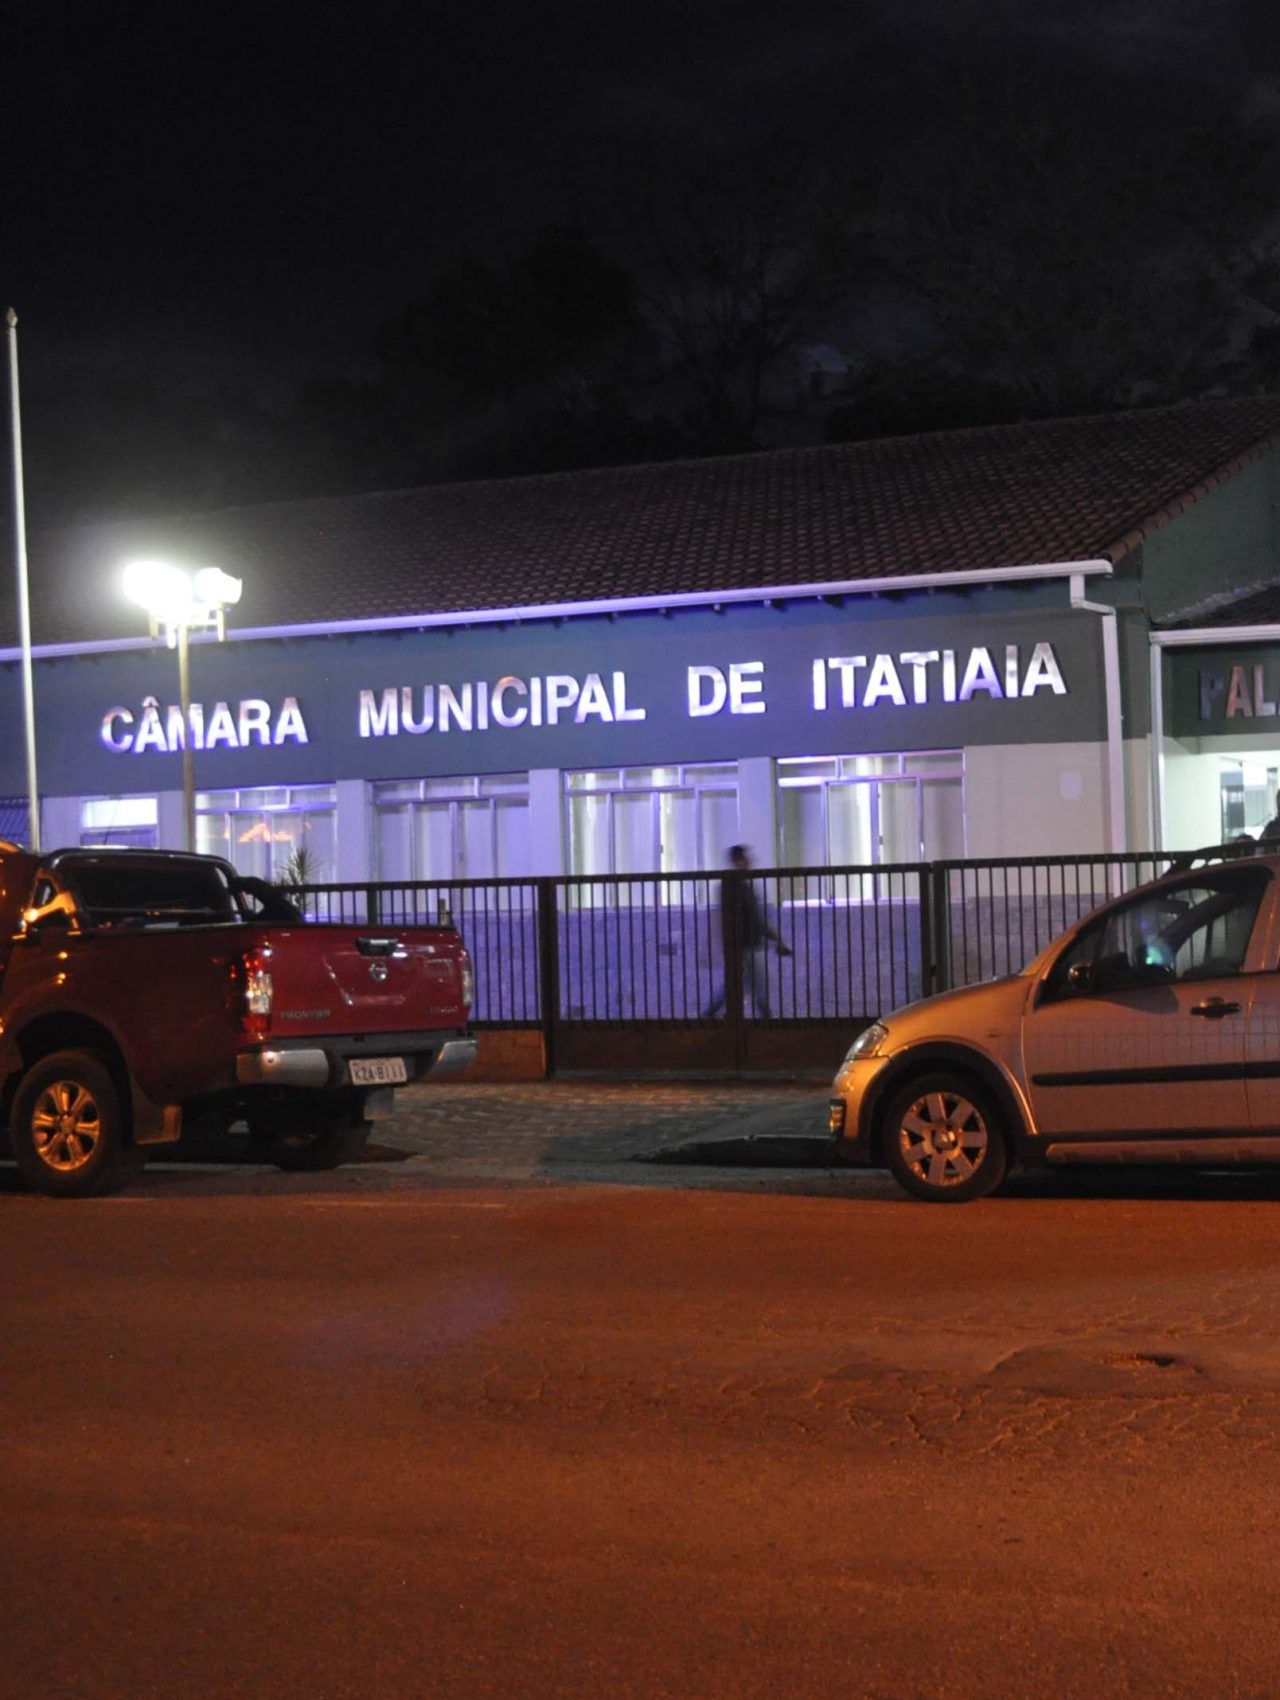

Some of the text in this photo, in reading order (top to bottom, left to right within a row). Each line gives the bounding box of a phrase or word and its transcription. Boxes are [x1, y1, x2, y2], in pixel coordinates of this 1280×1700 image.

[101, 641, 1068, 753] CÂMARA MUNICIPAL DE ITATIAIA
